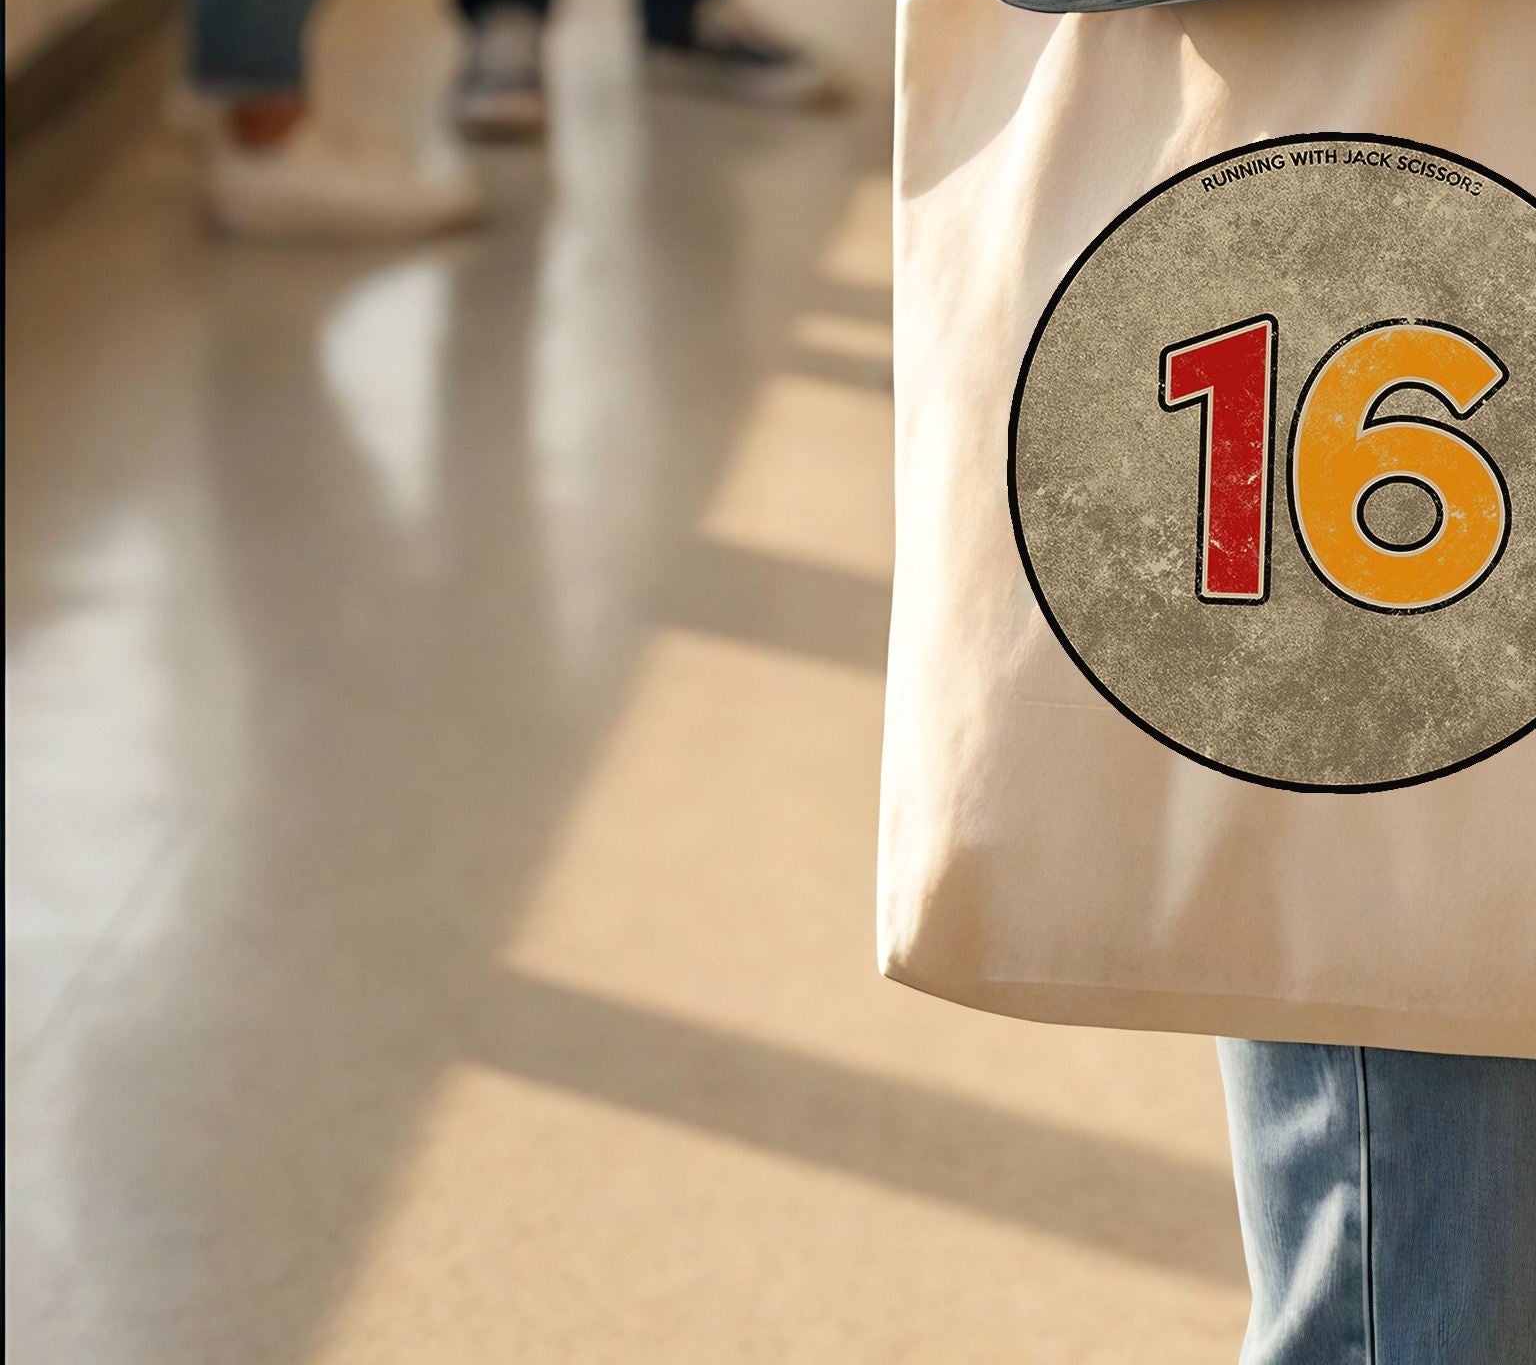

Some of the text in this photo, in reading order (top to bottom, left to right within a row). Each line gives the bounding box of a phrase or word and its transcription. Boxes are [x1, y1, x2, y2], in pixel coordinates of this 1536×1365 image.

[1201, 155, 1286, 192] RUNNING
[1291, 149, 1337, 165] WITH
[1343, 150, 1391, 168] JACK
[1158, 313, 1512, 615] 16
